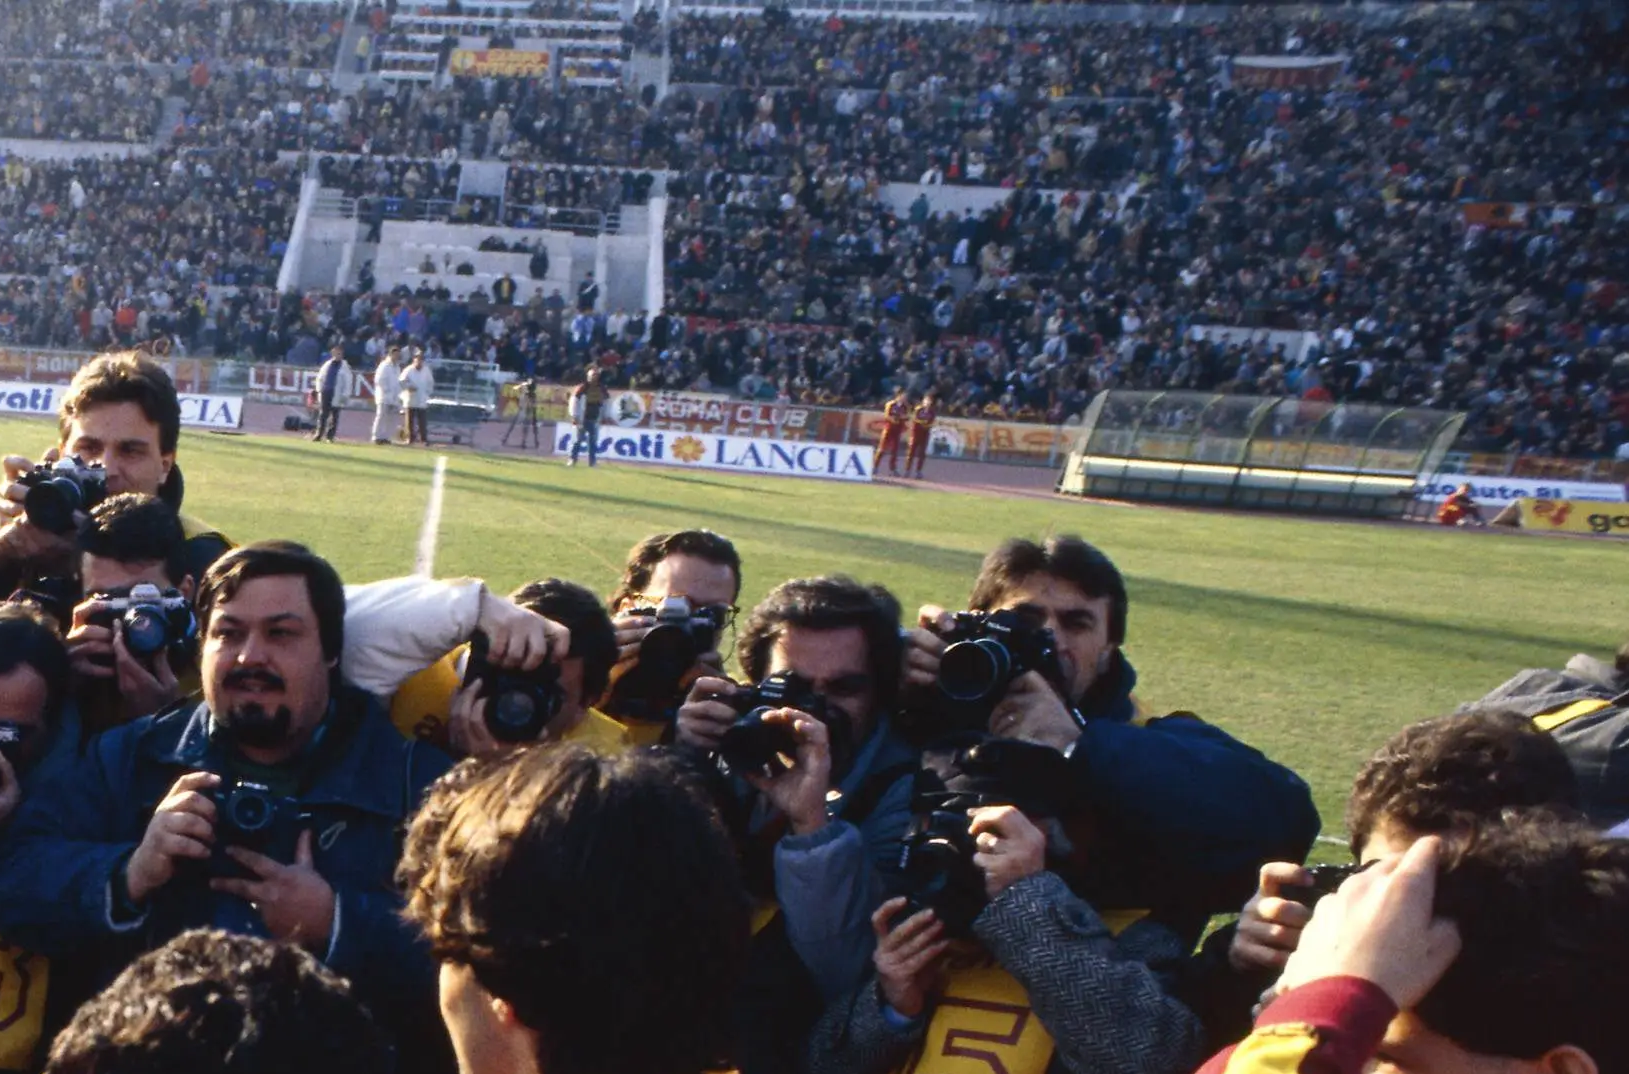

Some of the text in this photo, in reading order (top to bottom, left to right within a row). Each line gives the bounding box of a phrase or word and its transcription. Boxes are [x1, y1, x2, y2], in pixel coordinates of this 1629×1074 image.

[655, 398, 809, 428] ROMA CLUB
[715, 438, 868, 477] LANCIA
